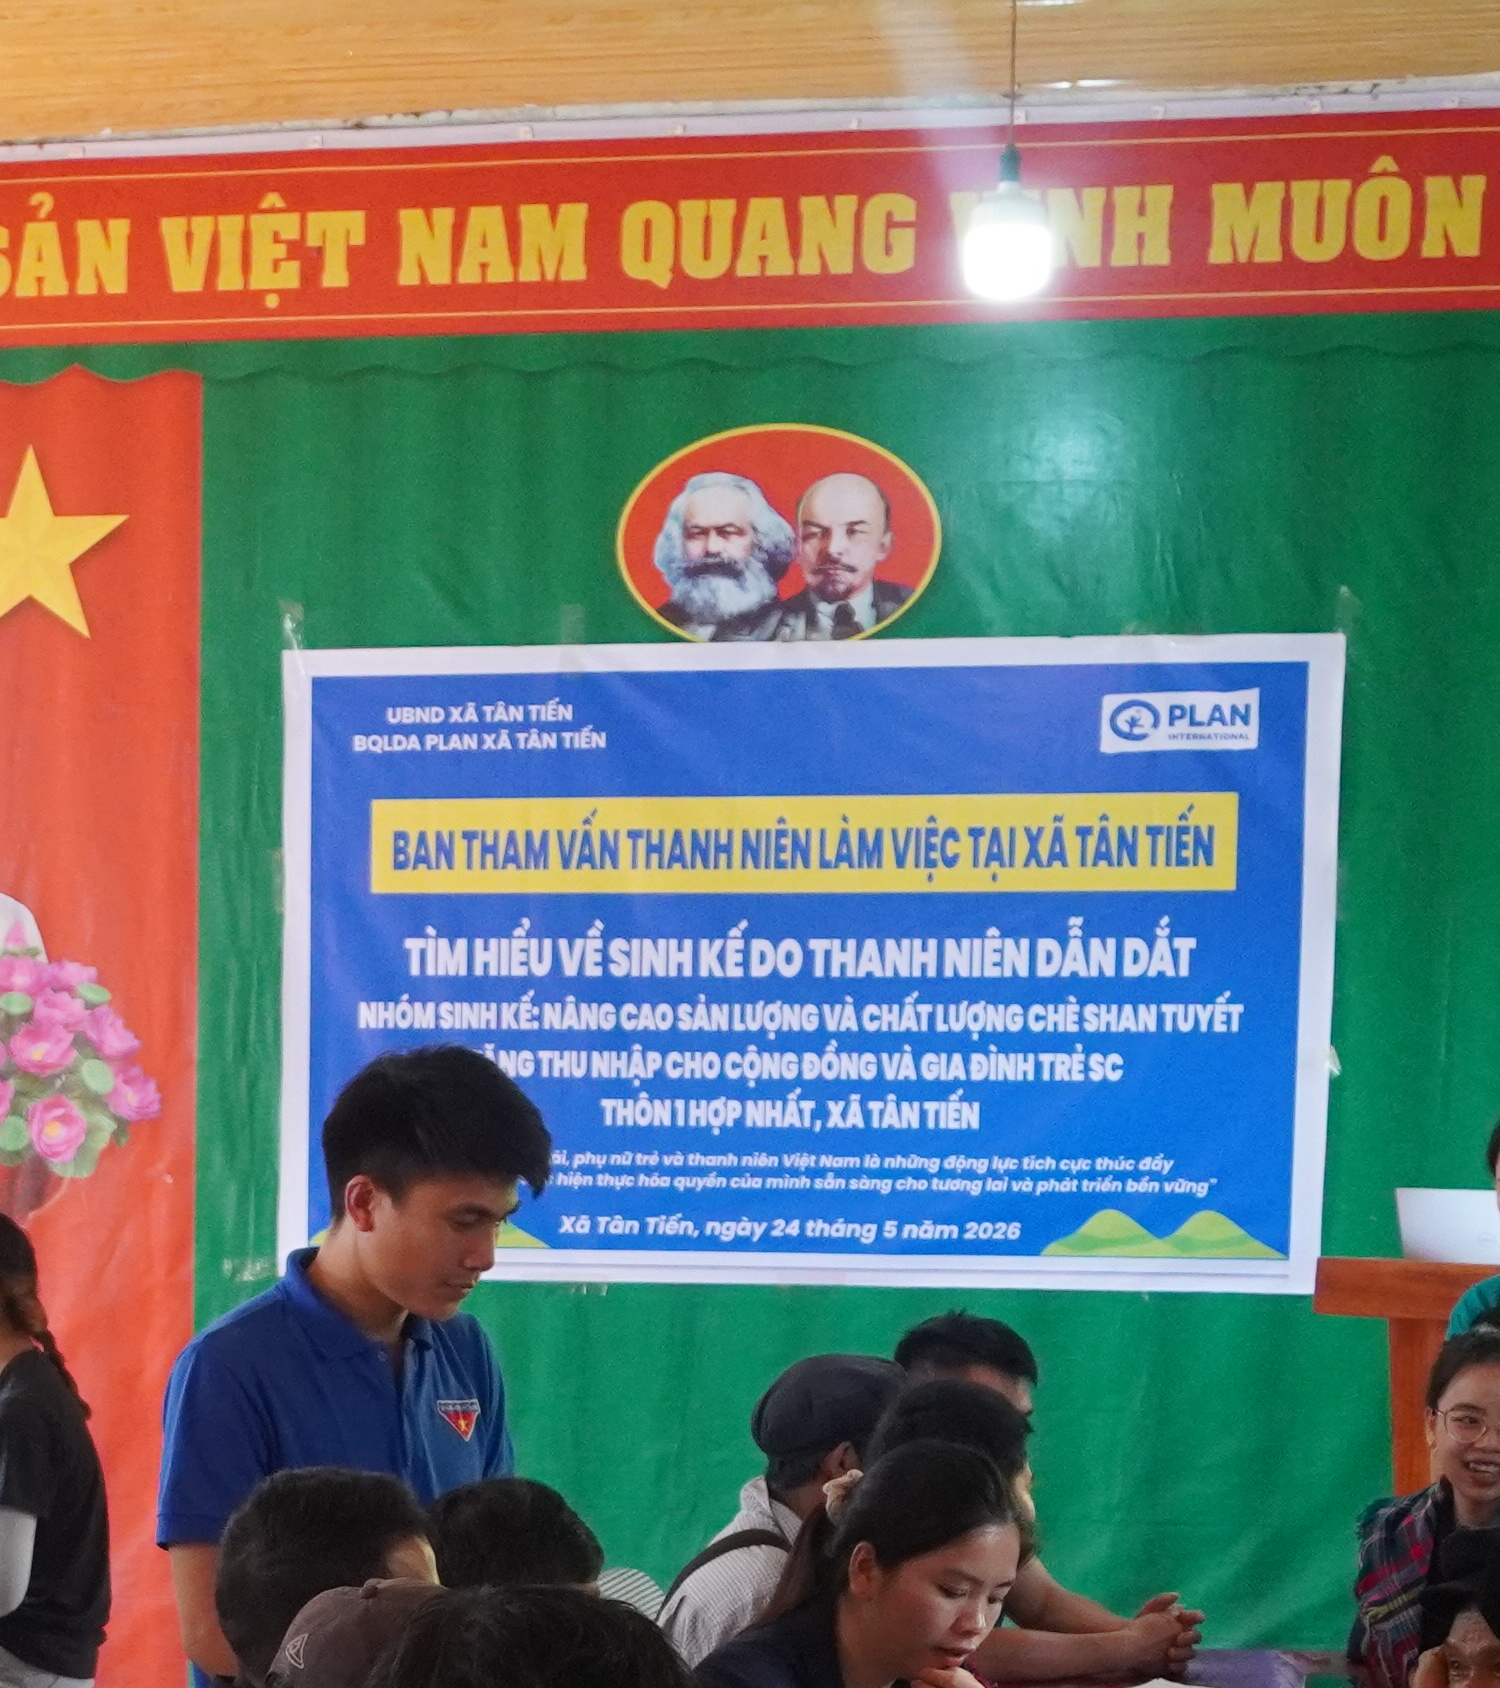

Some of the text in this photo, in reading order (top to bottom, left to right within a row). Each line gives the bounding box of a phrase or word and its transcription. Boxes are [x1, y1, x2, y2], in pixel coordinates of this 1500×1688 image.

[159, 191, 366, 309] VIỆT
[397, 202, 589, 286] NAM
[621, 193, 917, 289] QUANG
[1207, 155, 1488, 266] MUÔN
[386, 697, 573, 725] UBND XÃ TÂN TIẾN
[1168, 703, 1252, 728] PLAN
[353, 724, 607, 754] BQLDA PLAN XÃ TÂN TIẾN
[1168, 732, 1250, 741] INTERNATIONAL
[391, 803, 1216, 883] BAN THAM VẤN THANH NIÊN LÀM VIỆC TẠI XÃ TÂN TIẾN
[404, 915, 1197, 978] TÌM HIỂU VỀ SINH KẾ DO THANH NIÊN DẪN DẮT
[359, 989, 1245, 1041] NHÓM SINH KẾ: NÂNG CAO SẢN LƯỢNG VÀ CHẤT LƯỢNG CHÈ SHAN TUYẾT
[538, 1050, 587, 1078] THU
[591, 1043, 663, 1086] NHẬP
[666, 1051, 721, 1079] CHO
[724, 1044, 799, 1088] CỘNG
[802, 1039, 878, 1080] ĐỒNG
[881, 1044, 917, 1080] VÀ
[920, 1053, 967, 1080] GIA
[969, 1044, 1035, 1081] ĐÌNH
[1039, 1043, 1085, 1081] TRẺ
[1088, 1052, 1124, 1081] SC
[601, 1091, 672, 1126] THÔN
[826, 1093, 865, 1129] XÃ
[868, 1093, 920, 1129] TÂN
[923, 1088, 981, 1129] TIẾN
[573, 1151, 607, 1169] phụ
[609, 1151, 635, 1166] nữ
[635, 1151, 660, 1166] trẻ
[662, 1151, 684, 1166] và
[687, 1153, 738, 1167] thanh
[741, 1152, 779, 1167] niên
[782, 1152, 816, 1171] Việt
[819, 1154, 861, 1169] Nam
[863, 1153, 882, 1169] là
[884, 1153, 941, 1173] những
[943, 1154, 989, 1174] động
[991, 1155, 1019, 1173] lực
[1022, 1155, 1056, 1170] tích
[1059, 1158, 1092, 1174] cực
[1094, 1155, 1136, 1171] thúc
[556, 1172, 593, 1190] hiện
[596, 1173, 635, 1190] thực
[637, 1172, 671, 1187] hóa
[674, 1171, 728, 1191] quyền
[730, 1173, 763, 1189] của
[765, 1174, 811, 1189] mình
[850, 1175, 893, 1194] sàng
[895, 1176, 928, 1190] cho
[931, 1177, 983, 1196] tương
[986, 1176, 1009, 1192] lai
[1011, 1177, 1033, 1191] và
[1036, 1177, 1078, 1196] phát
[1081, 1175, 1122, 1193] triển
[1125, 1175, 1160, 1193] bền
[558, 1213, 1021, 1244] Xã Tân Tiến, ngày 24 tháng 5 năm 2026
